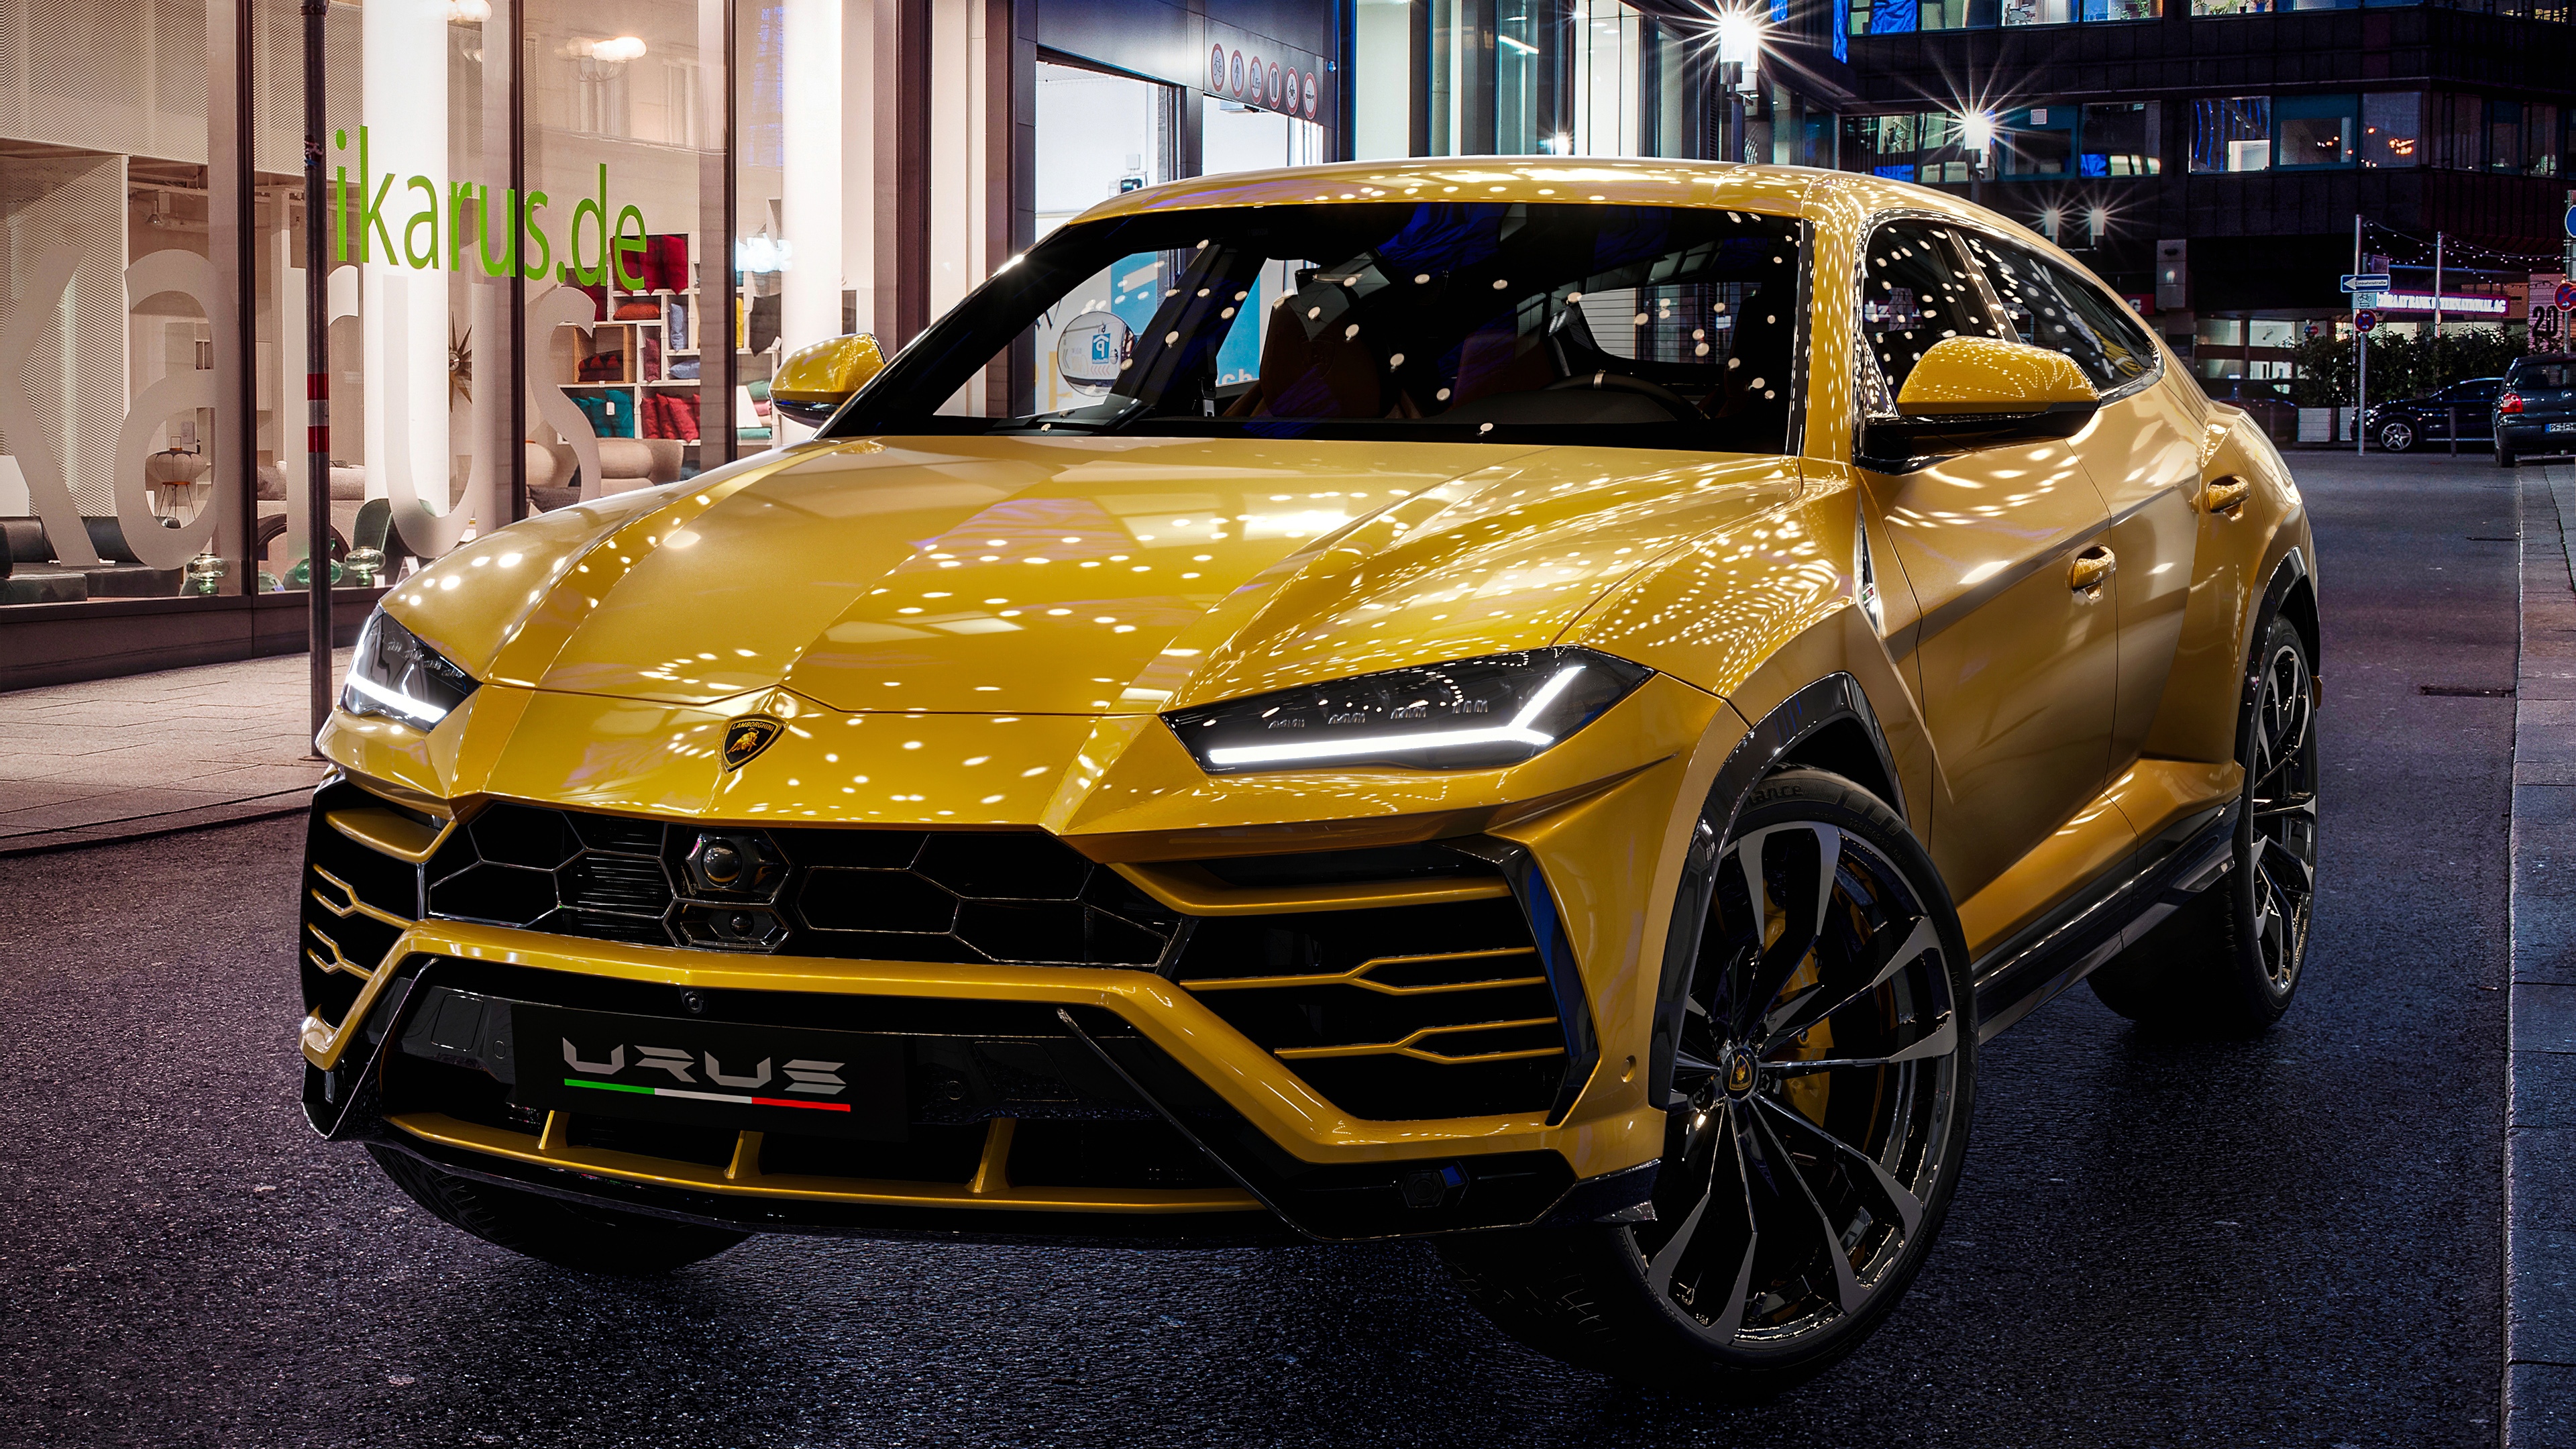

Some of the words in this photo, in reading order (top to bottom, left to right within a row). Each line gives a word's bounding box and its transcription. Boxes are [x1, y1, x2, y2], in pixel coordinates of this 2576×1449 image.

[335, 125, 647, 290] ikarus.de
[2532, 305, 2558, 337] 20
[732, 721, 775, 732] LAMBORGHINI
[561, 1036, 847, 1095] URUS
